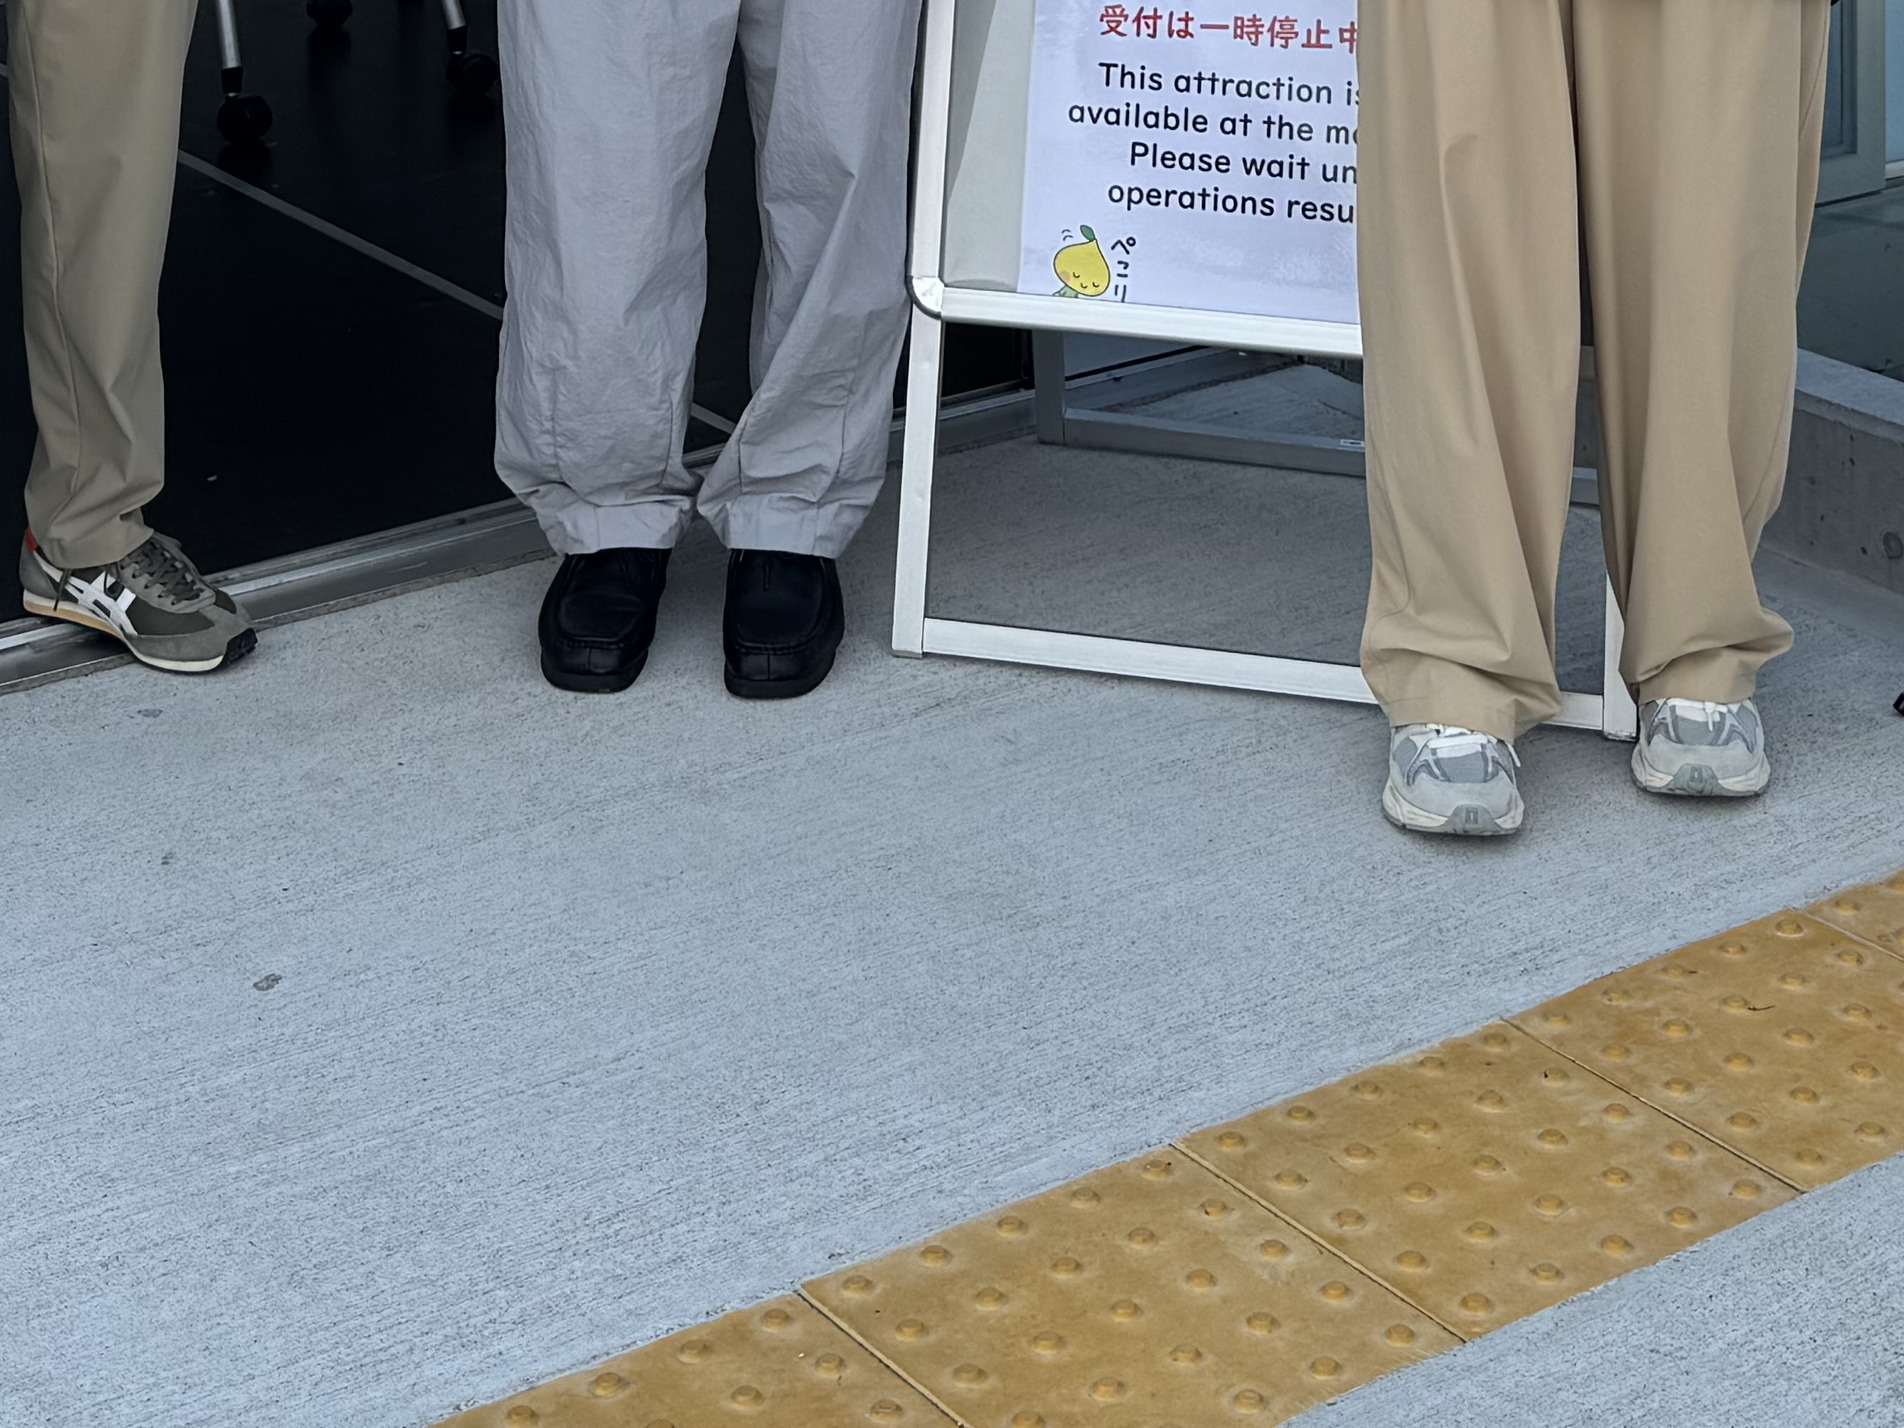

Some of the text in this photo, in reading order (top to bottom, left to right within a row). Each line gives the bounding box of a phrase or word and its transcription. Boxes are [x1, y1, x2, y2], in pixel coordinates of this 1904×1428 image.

[1098, 61, 1163, 91] This
[1173, 71, 1333, 105] attraction
[1068, 102, 1208, 133] available
[1219, 112, 1253, 137] at
[1262, 114, 1314, 140] the
[1130, 141, 1231, 174] Please
[1242, 154, 1311, 181] wait
[1108, 184, 1355, 224] operations resu
